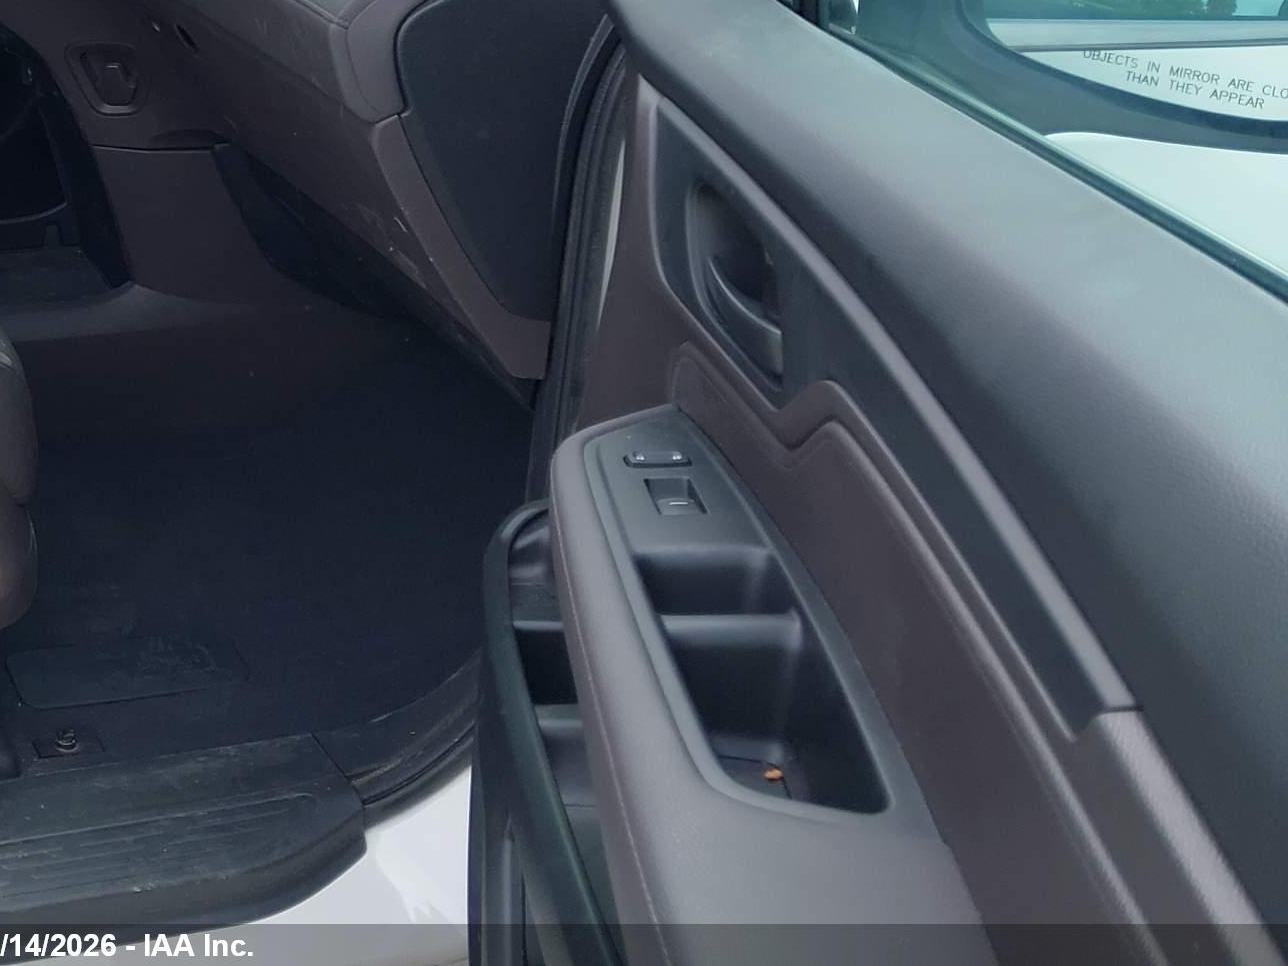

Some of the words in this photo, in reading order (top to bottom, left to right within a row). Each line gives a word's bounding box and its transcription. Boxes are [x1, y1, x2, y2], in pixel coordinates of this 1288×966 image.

[1083, 50, 1139, 69] OBJECTS
[1146, 60, 1161, 73] IN
[1168, 65, 1221, 84] MIRROR
[1227, 77, 1256, 92] ARE
[1124, 70, 1160, 87] THAN
[1168, 80, 1203, 96] THEY
[1208, 88, 1265, 110] APPEAR
